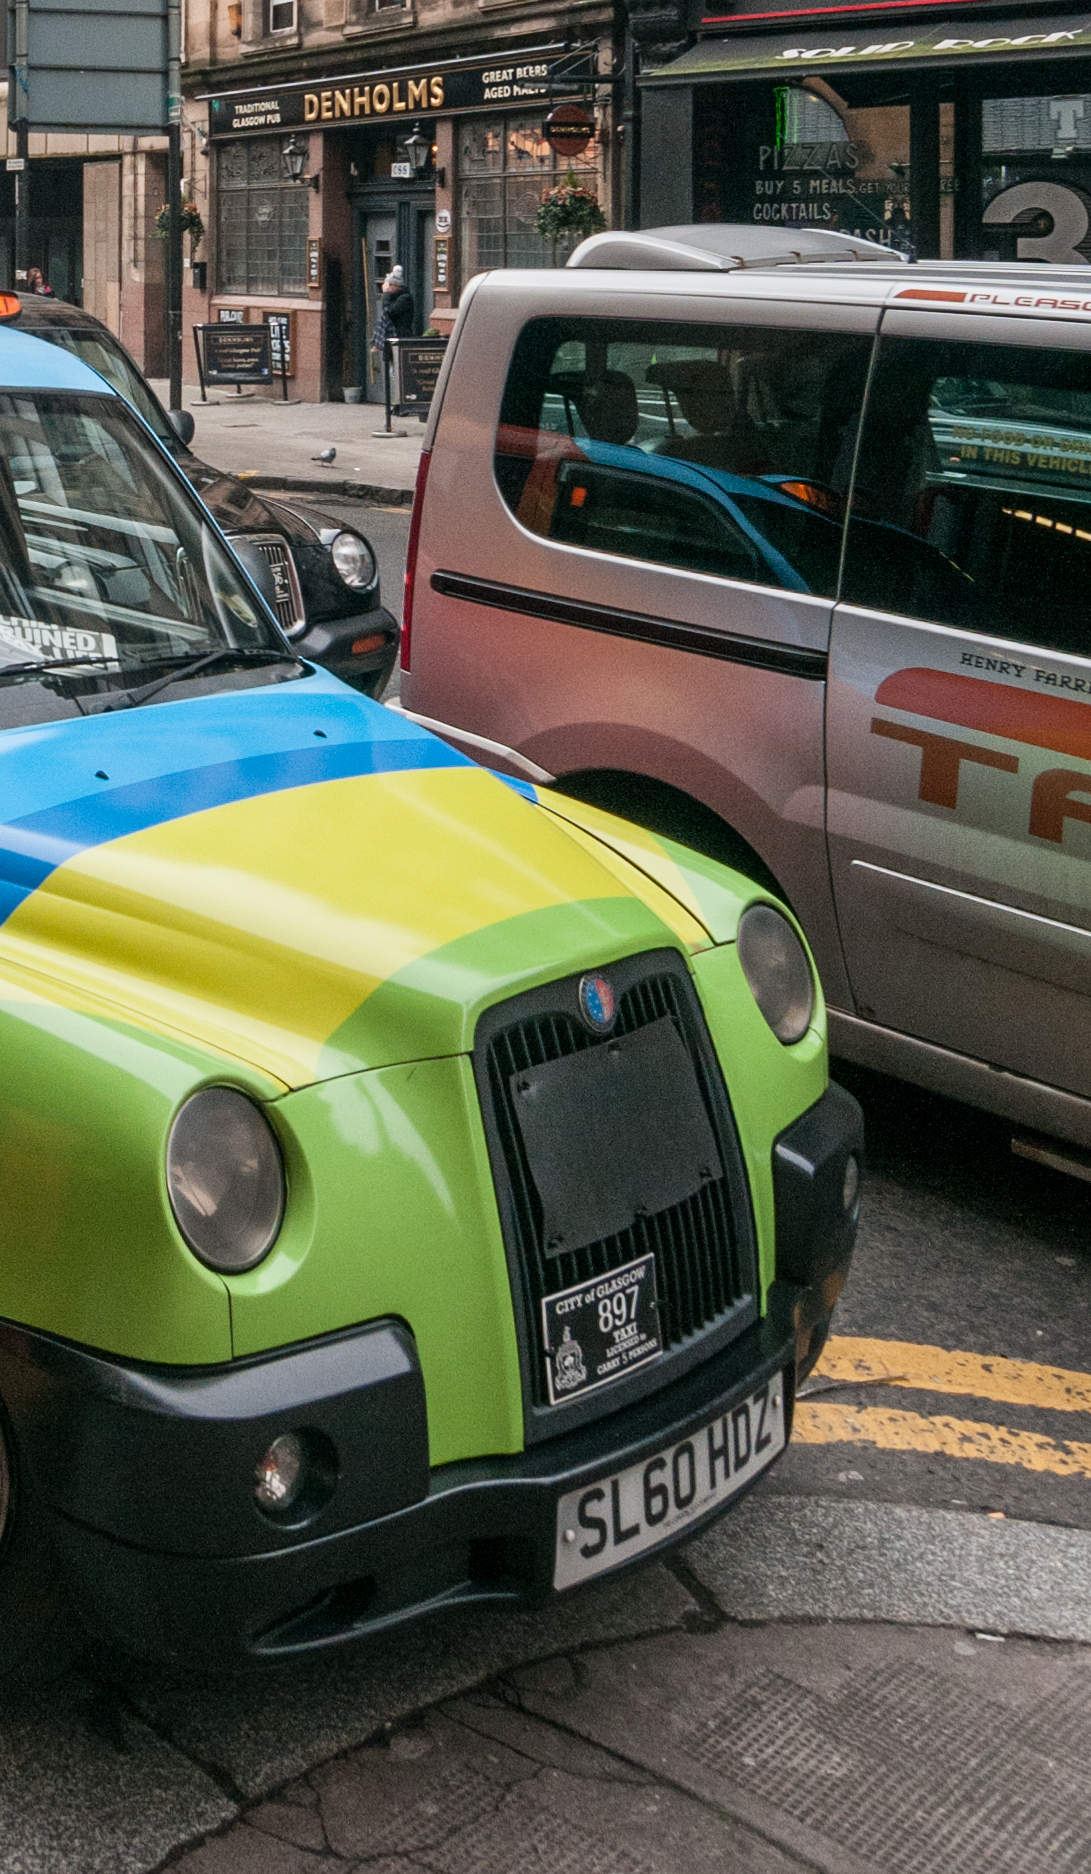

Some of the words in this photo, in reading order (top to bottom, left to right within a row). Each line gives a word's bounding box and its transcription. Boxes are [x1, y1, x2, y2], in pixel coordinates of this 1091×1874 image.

[776, 41, 915, 59] SOLID
[933, 29, 1083, 50] ROCK
[482, 69, 514, 83] GREAT
[516, 65, 548, 79] BEERS
[304, 76, 445, 122] DENHOLMS
[484, 86, 510, 99] AGED
[233, 116, 265, 128] GLASGOW
[266, 114, 281, 124] PUB
[235, 101, 280, 115] TRADITIONAL
[760, 141, 859, 171] PIZZAS
[755, 180, 783, 195] BUY
[793, 180, 802, 194] 5
[859, 183, 880, 194] GET
[753, 203, 831, 221] COCKTAILS
[981, 181, 1089, 263] 3
[960, 445, 978, 459] IN
[983, 446, 1021, 465] THIS
[1027, 453, 1091, 475] VEHICL
[960, 652, 1027, 678] HENRY
[1034, 669, 1091, 695] FARR
[555, 1294, 584, 1315] CITY
[584, 1288, 596, 1304] of
[596, 1265, 646, 1299] GLASGOW
[597, 1284, 639, 1334] 897
[612, 1321, 638, 1343] TAXI
[621, 1353, 628, 1364] 5
[577, 1440, 697, 1559] SL60
[707, 1381, 772, 1490] HDZ
